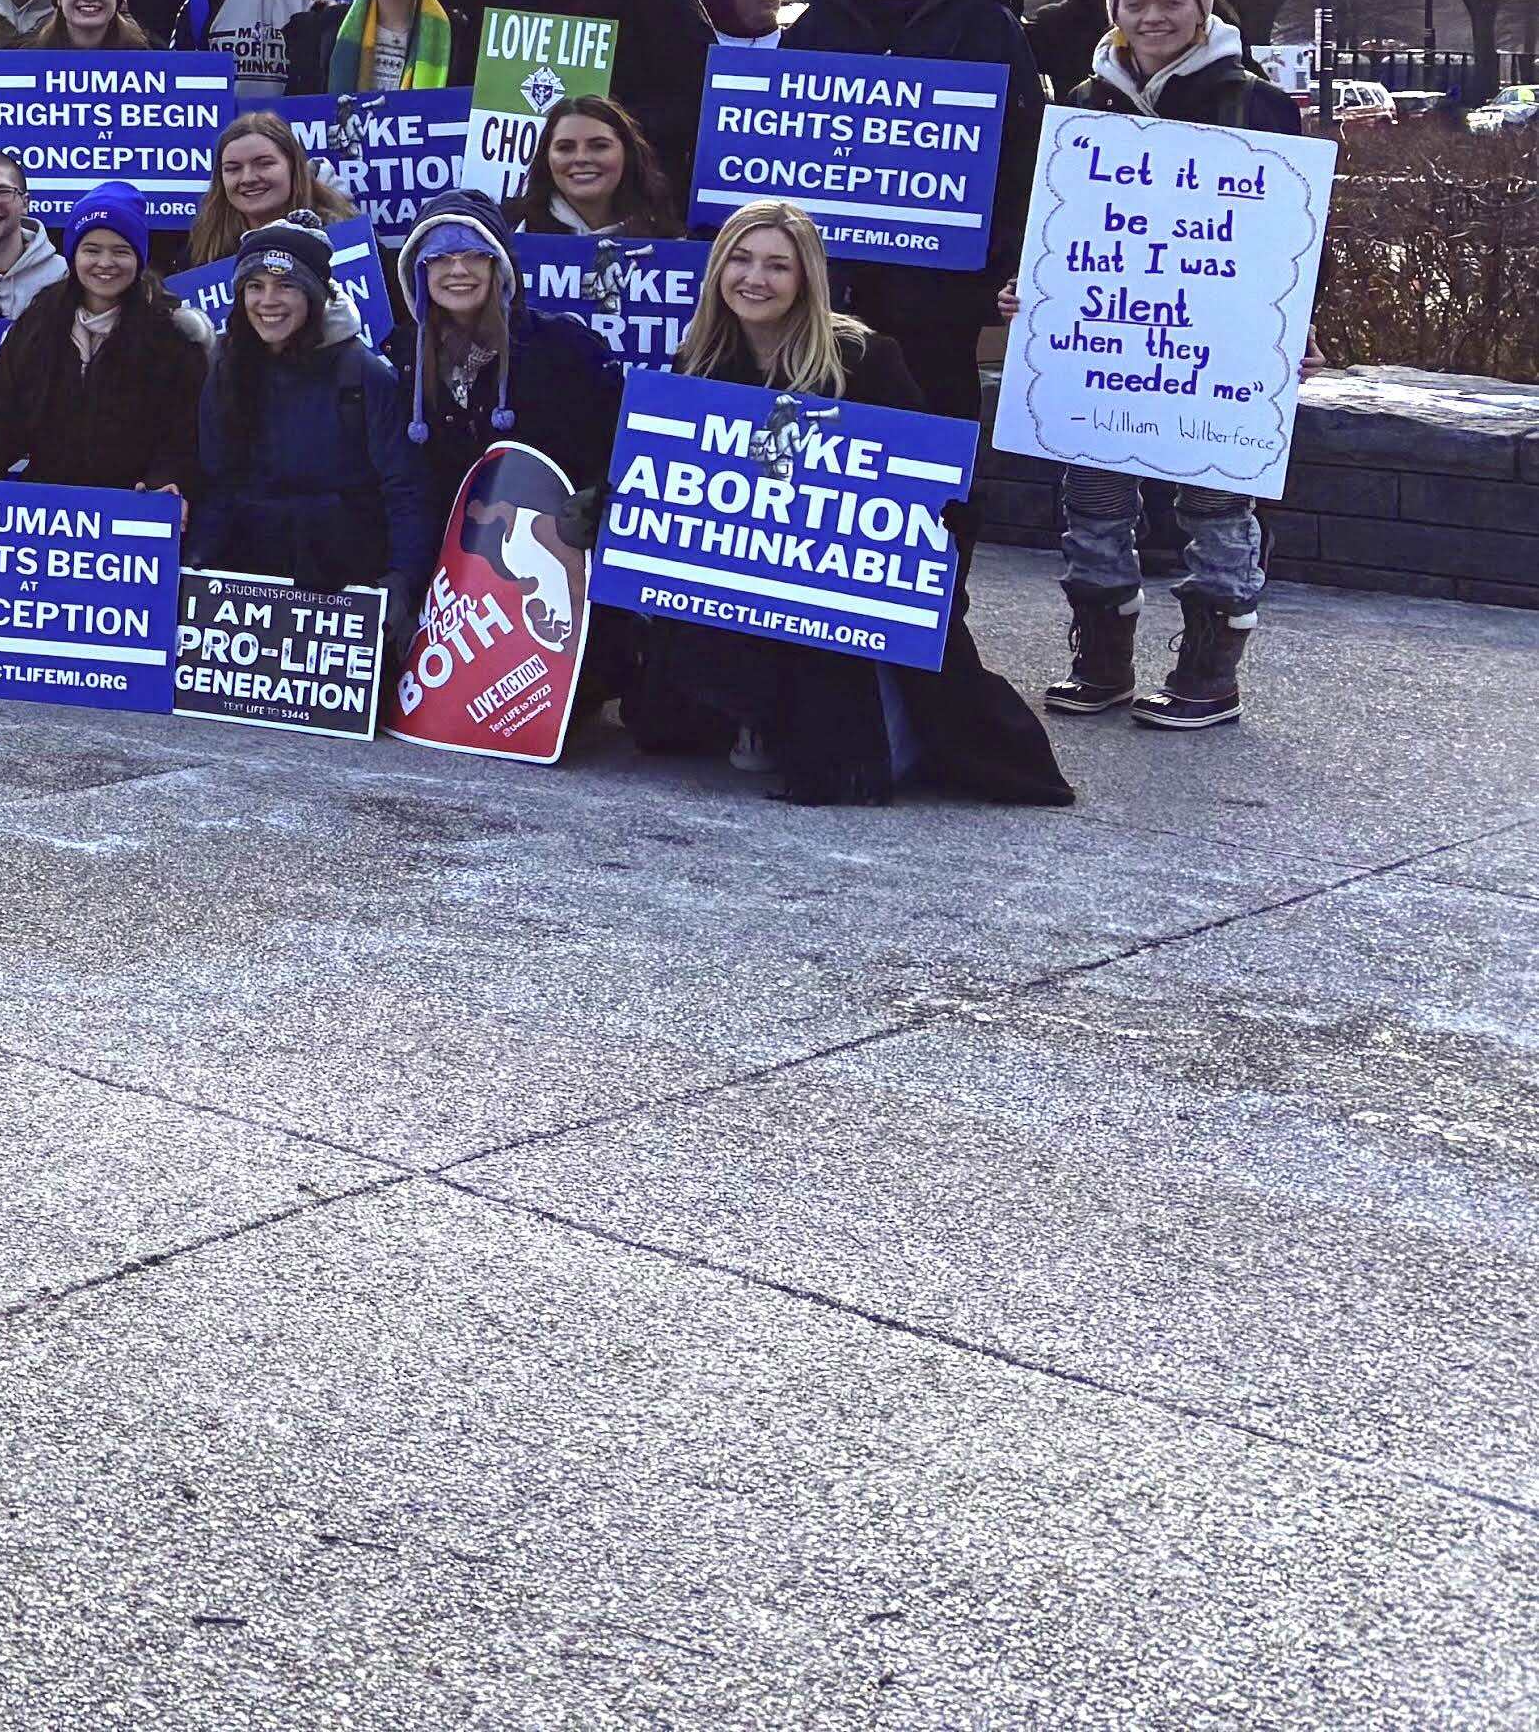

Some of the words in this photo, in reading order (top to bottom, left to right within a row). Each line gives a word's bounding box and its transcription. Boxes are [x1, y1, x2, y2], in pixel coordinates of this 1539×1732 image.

[486, 12, 553, 63] LOVE
[557, 20, 611, 69] LIFE
[45, 70, 166, 94] HUMAN
[779, 72, 922, 109] HUMAN
[98, 131, 113, 140] AT
[121, 104, 218, 128] BEGIN
[717, 106, 853, 141] RIGHTS
[863, 117, 981, 152] BEGIN
[833, 146, 852, 158] AT
[719, 155, 967, 203] CONCEPTION
[1176, 158, 1199, 190] it
[1218, 165, 1266, 196] not
[1104, 202, 1149, 235] be
[1171, 209, 1234, 242] said
[1066, 240, 1125, 273] that
[1144, 243, 1168, 275] I
[1180, 257, 1237, 278] was
[539, 264, 695, 305] MKE
[1080, 285, 1191, 326] Silent
[1050, 321, 1123, 354] when
[1145, 327, 1210, 370] they
[1085, 363, 1198, 396] needed
[701, 414, 883, 480] MKE
[1179, 415, 1275, 451] Wilberforce
[617, 455, 949, 552] ABORTION
[47, 549, 159, 585] BEGIN
[609, 504, 948, 597] UNTHINKABLE
[20, 581, 39, 592] AT
[225, 583, 352, 607] STUDENTSFORLIFE.ORG
[187, 596, 197, 620] I
[214, 599, 272, 629] AM
[291, 607, 364, 639] THE
[641, 586, 887, 651] PROTECTLIFEMI.ORG
[176, 625, 374, 680] PRO-LIFE
[398, 592, 514, 716] BOTH
[175, 665, 365, 713] GENERATION
[246, 704, 265, 715] LIFE
[504, 707, 522, 724] LIFE
